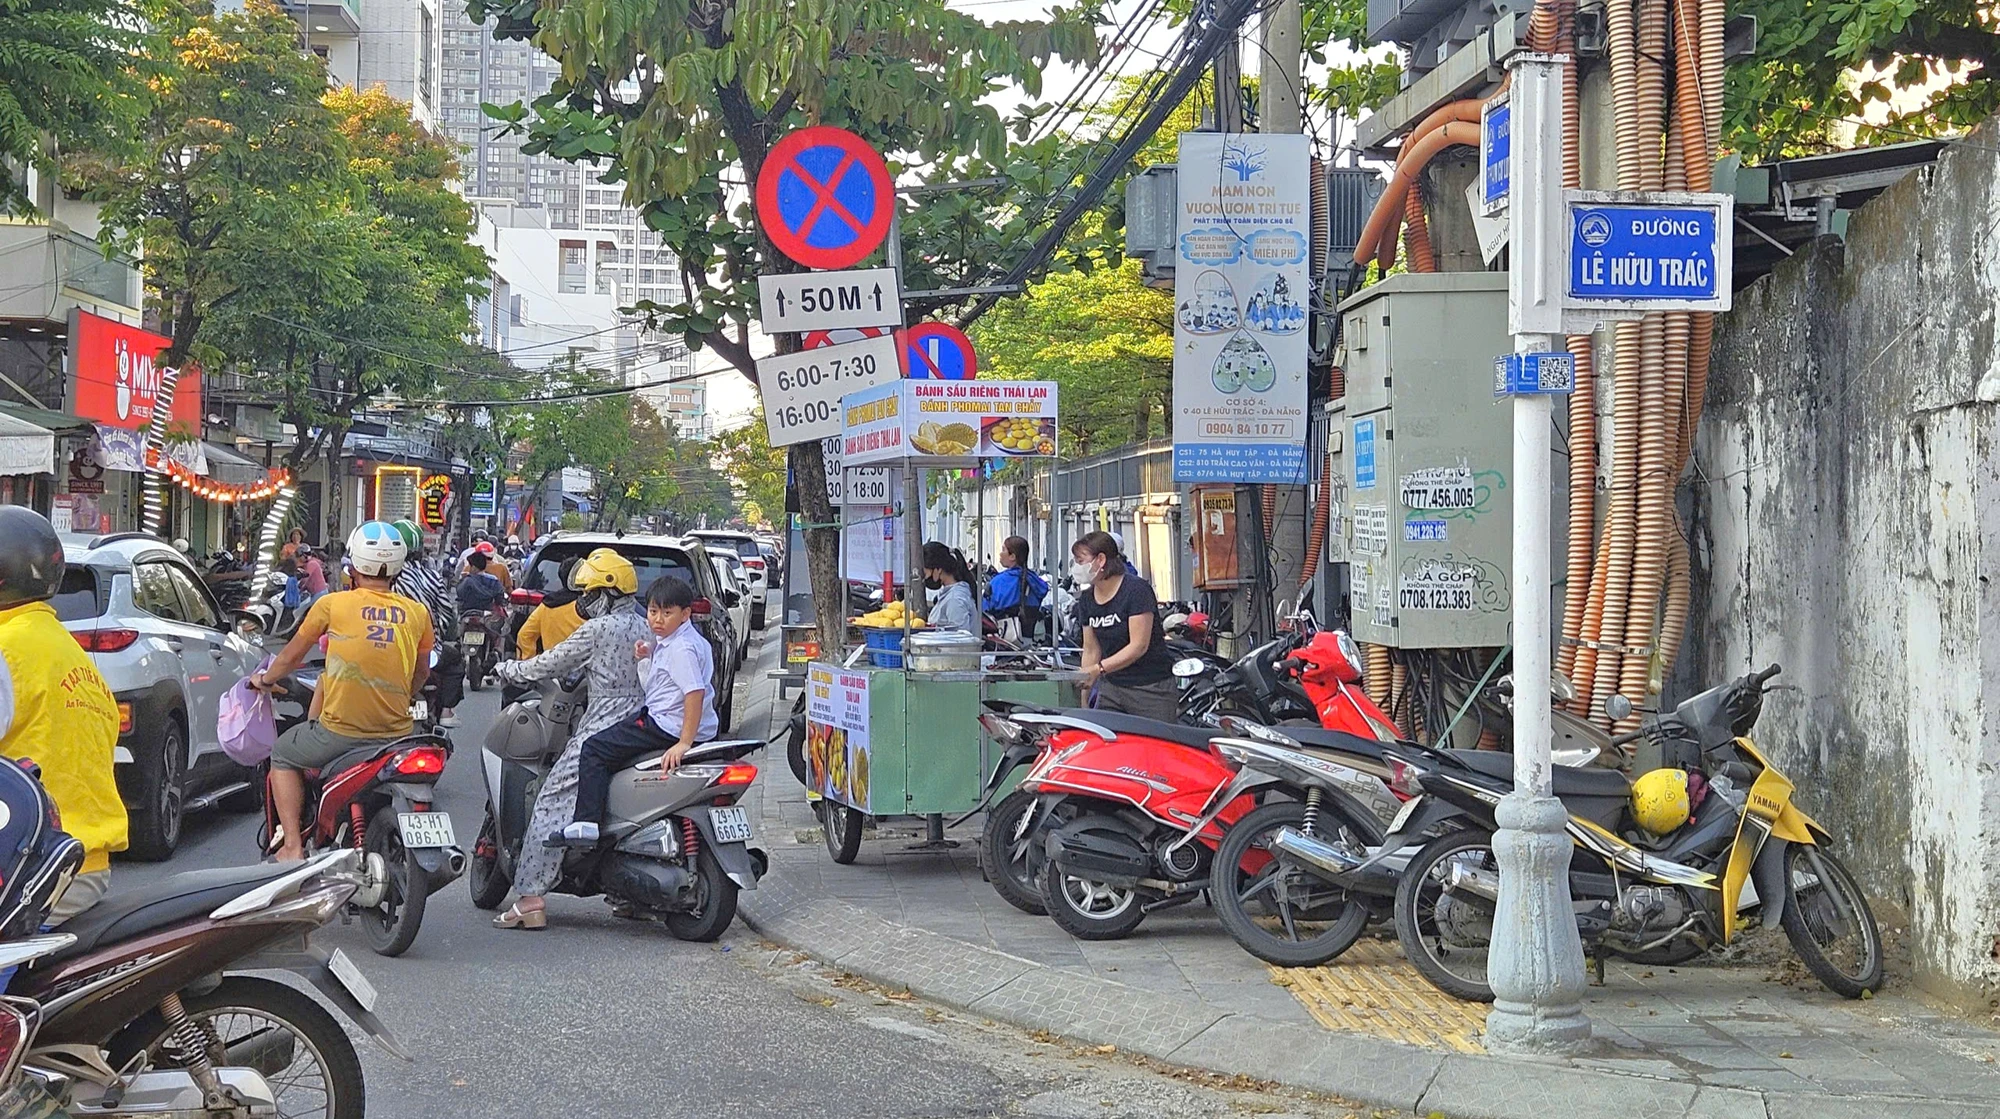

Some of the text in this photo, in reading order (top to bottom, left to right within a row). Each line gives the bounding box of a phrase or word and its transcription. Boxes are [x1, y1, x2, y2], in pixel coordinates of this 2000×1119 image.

[1631, 216, 1700, 236] ĐƯỜNG
[1486, 233, 1503, 255] NGUY
[1582, 251, 1708, 287] LÊ HỮU TRÁC
[801, 286, 861, 313] 50M
[777, 354, 876, 391] 6:00-7:30
[916, 385, 943, 397] BÁNH
[970, 385, 1000, 398] RIÊNG
[1003, 385, 1025, 398] THÁI
[1028, 387, 1047, 399] LAN
[920, 399, 1042, 413] BÁNH PHOMAI TAN CHẢY
[1226, 398, 1240, 406] CƠ
[1242, 397, 1256, 406] SỞ
[776, 396, 842, 428] 16:00-
[1191, 407, 1201, 415] 40
[1203, 406, 1211, 415] LÊ
[1213, 406, 1230, 415] HỮU
[1233, 406, 1255, 415] TRÁC
[1262, 407, 1274, 415] ĐÀ
[1206, 423, 1285, 434] 0904 84 10 77
[1211, 448, 1222, 456] HÀ
[1244, 448, 1258, 458] TẬP
[1268, 448, 1278, 456] ĐÀ
[1270, 459, 1281, 467] ĐÀ
[1217, 468, 1227, 477] HÀ
[1248, 469, 1261, 479] TẬP
[1269, 469, 1279, 478] ĐÀ
[853, 482, 884, 498] 18:00
[1402, 488, 1473, 508] 0777.456.005
[1405, 525, 1446, 540] 0941.226.126
[1400, 589, 1471, 609] 0708.123.383
[1089, 613, 1121, 628] NASA
[366, 625, 395, 643] 21
[1752, 793, 1781, 814] YAMAHA
[408, 815, 443, 829] 43-H1
[715, 808, 743, 821] 29-Y1
[406, 830, 451, 845] 086.11
[717, 823, 751, 840] 660.53
